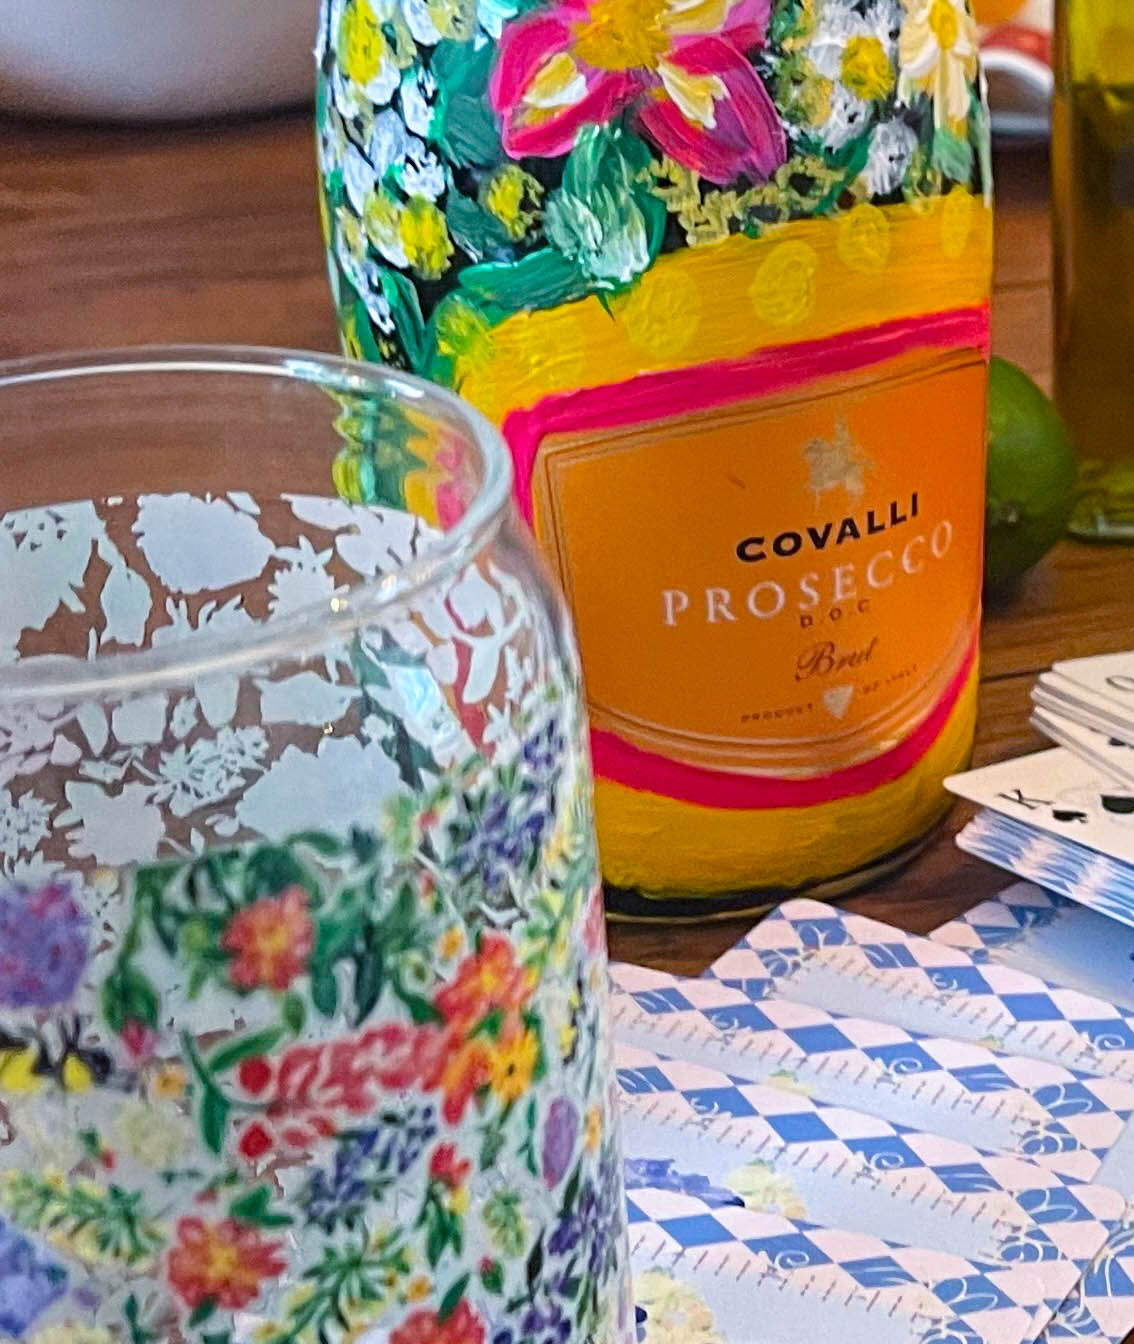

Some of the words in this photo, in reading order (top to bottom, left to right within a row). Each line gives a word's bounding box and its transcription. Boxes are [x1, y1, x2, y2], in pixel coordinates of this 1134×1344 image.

[735, 492, 919, 563] COVALLI
[661, 519, 952, 627] PROSECCO
[794, 636, 879, 682] Brut
[996, 788, 1055, 810] K
